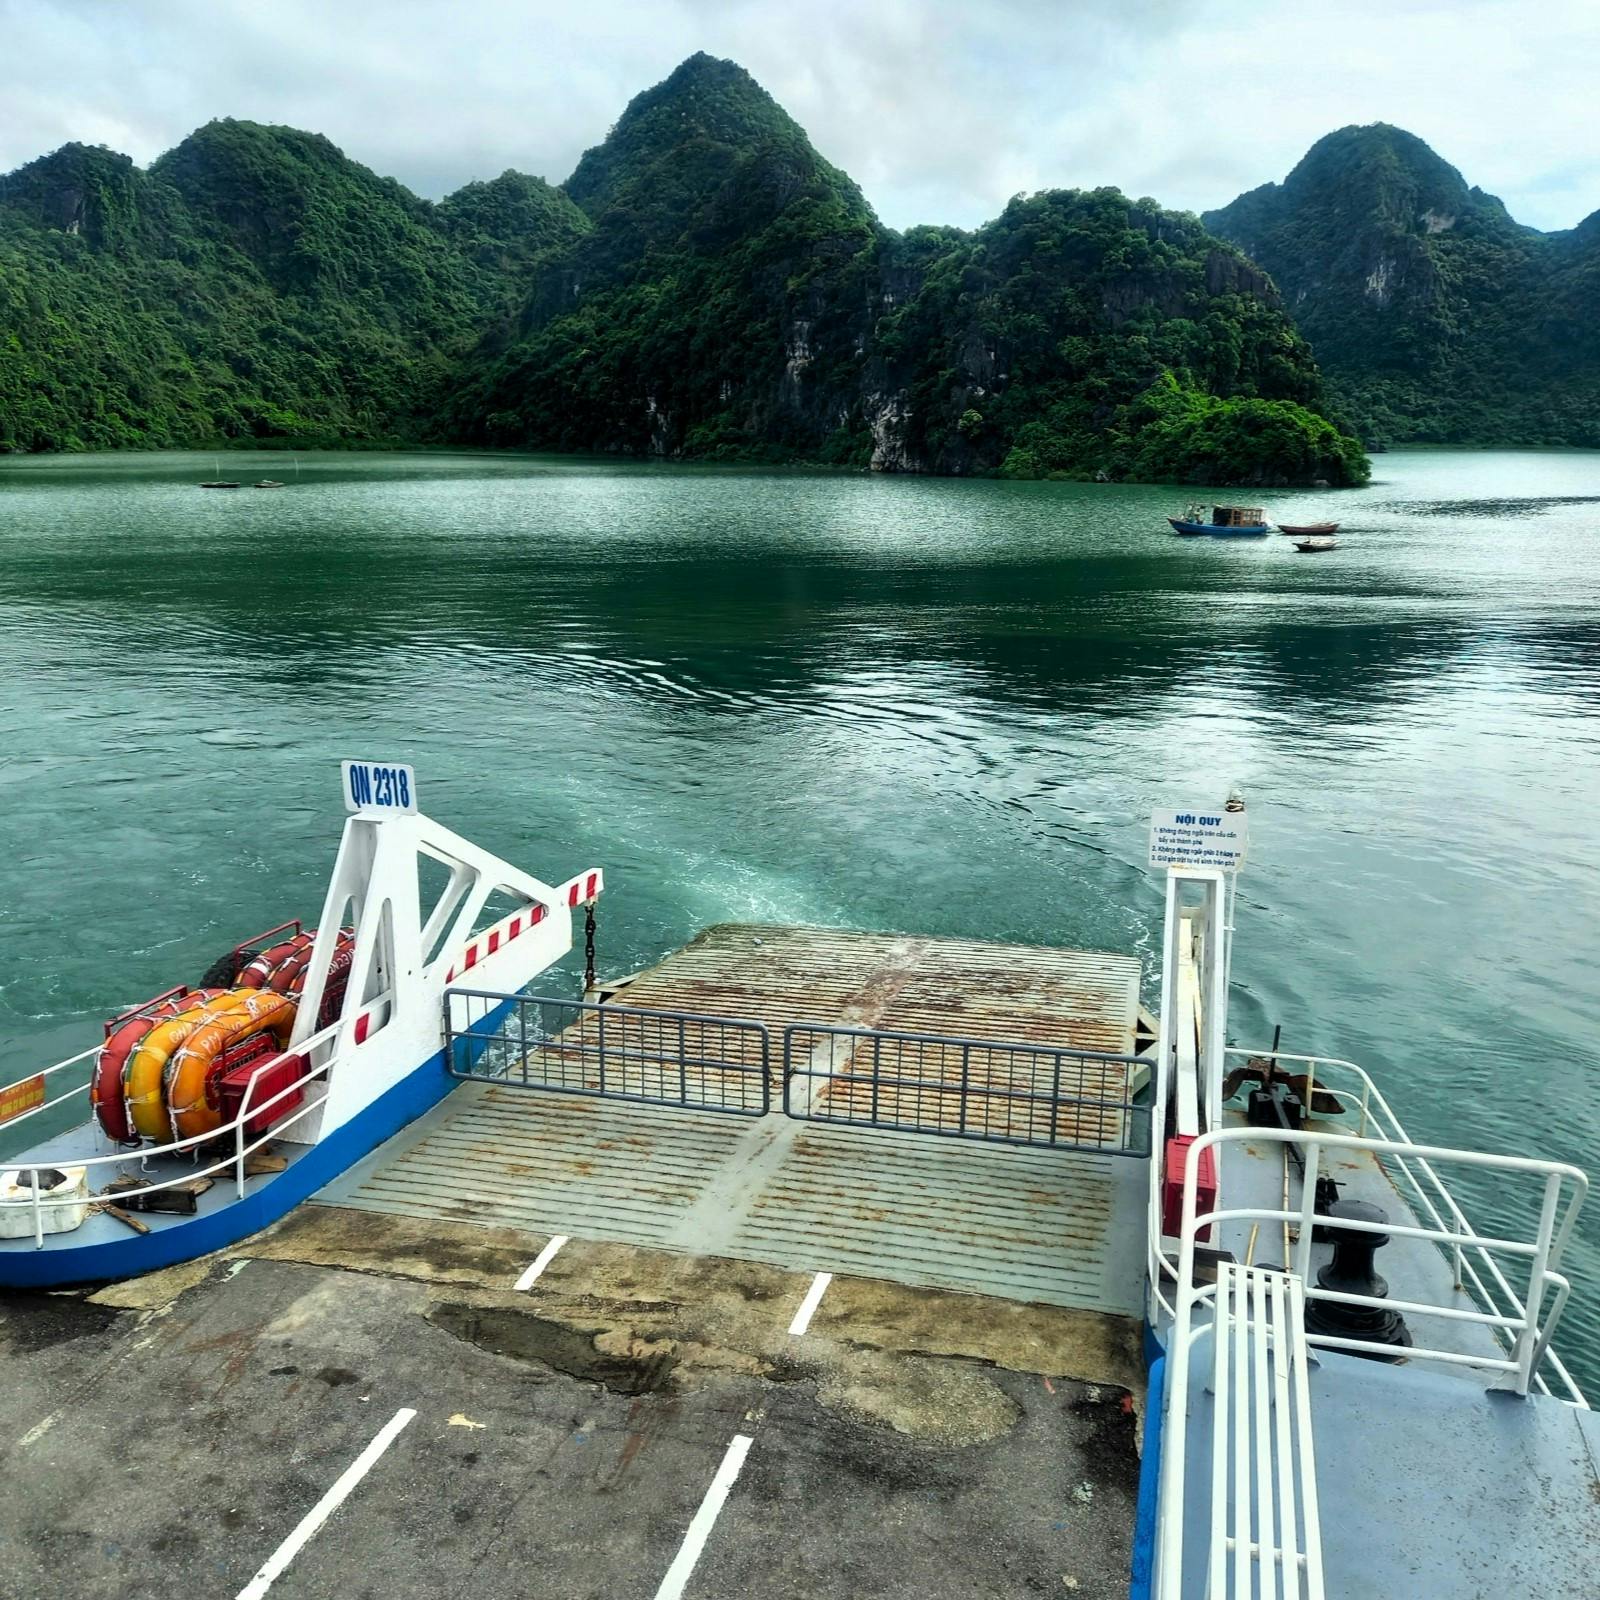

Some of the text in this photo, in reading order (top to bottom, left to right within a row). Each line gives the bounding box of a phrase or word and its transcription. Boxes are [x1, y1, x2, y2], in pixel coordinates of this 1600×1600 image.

[350, 764, 410, 808] QN 2318
[1176, 814, 1221, 826] NỘI QUY
